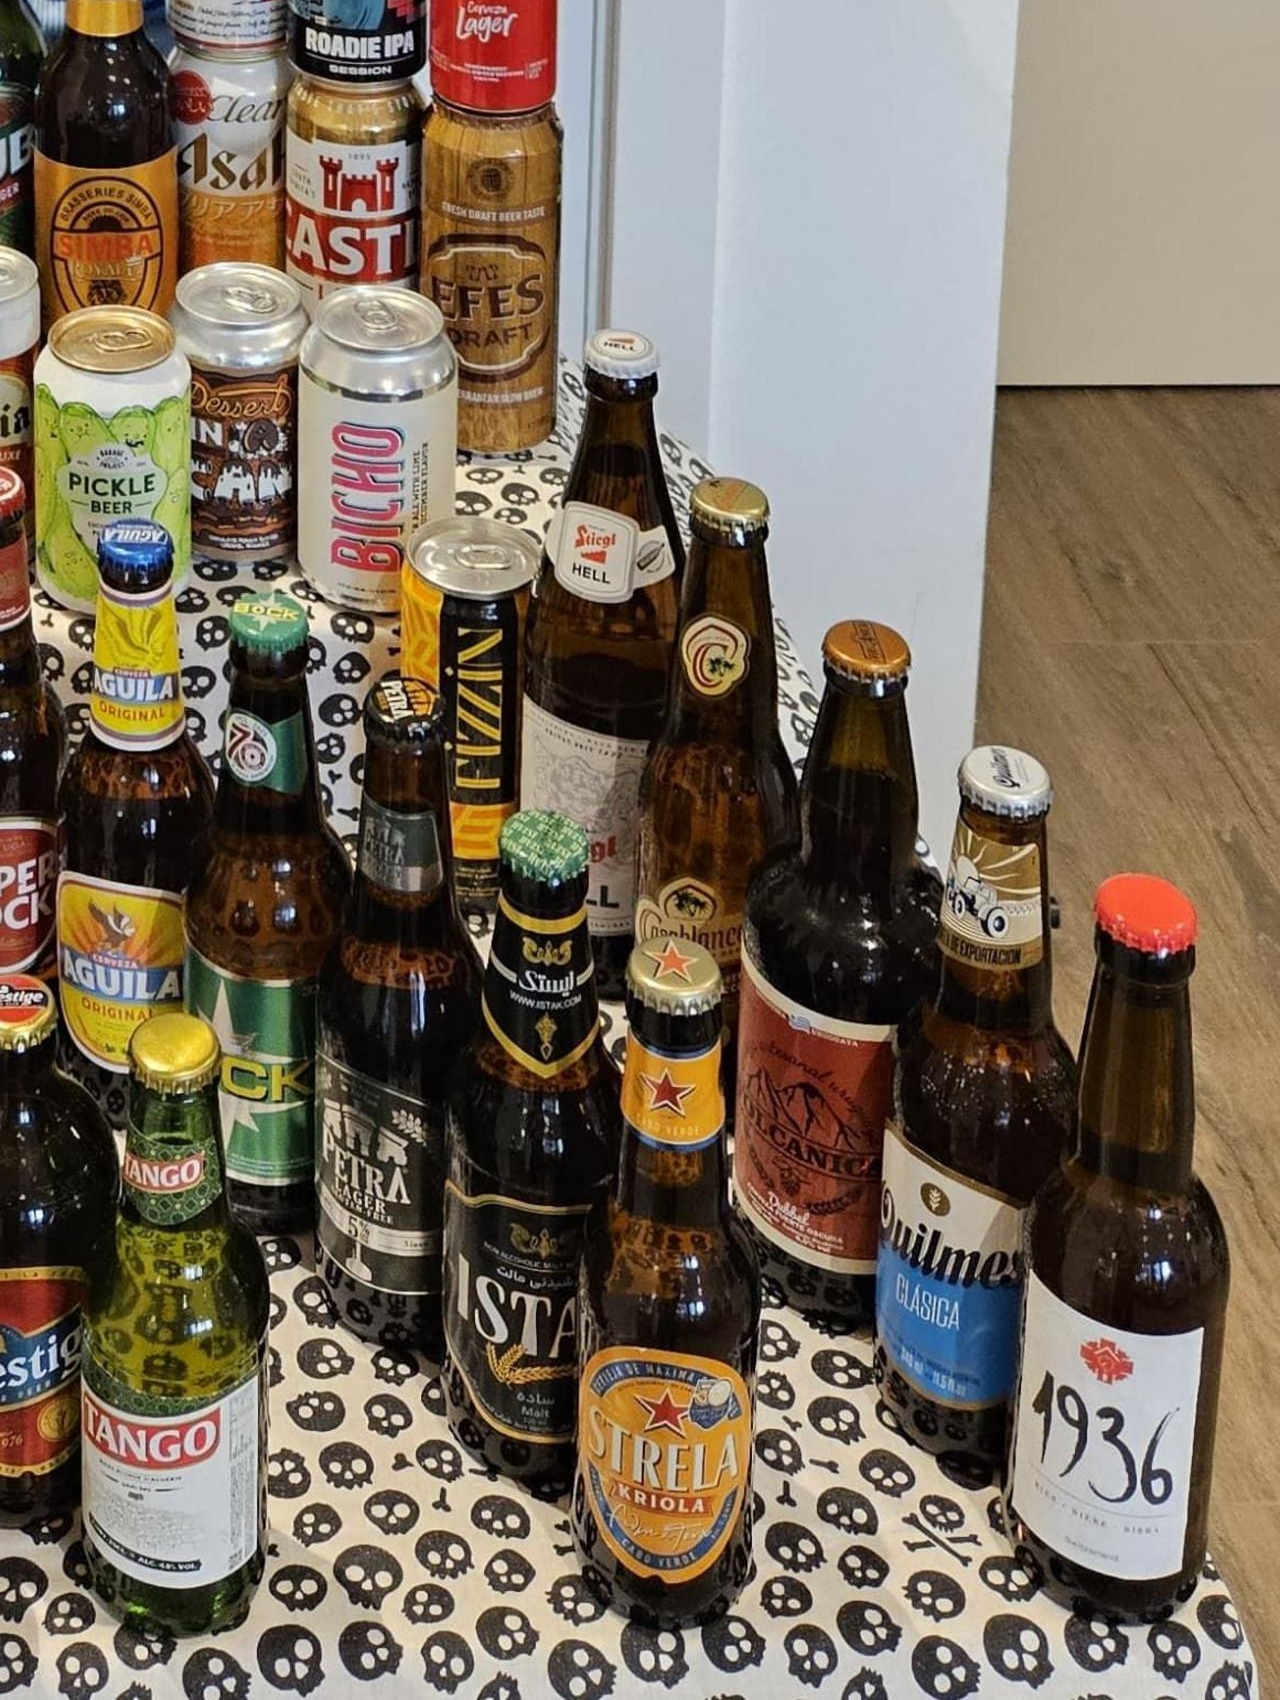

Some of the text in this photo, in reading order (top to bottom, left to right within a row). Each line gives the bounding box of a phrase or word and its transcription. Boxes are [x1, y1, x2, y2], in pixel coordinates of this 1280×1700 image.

[456, 6, 518, 42] Lager
[305, 26, 415, 60] ROADIE IPA
[328, 64, 392, 76] SESSION
[61, 185, 125, 223] BRASSERIES
[467, 208, 497, 223] DRAFT
[499, 210, 522, 222] BEER
[523, 205, 545, 220] TASTE
[58, 233, 155, 260] SIMBA
[431, 273, 546, 322] EFES
[449, 322, 533, 349] DRAFT
[603, 341, 636, 351] HELL
[191, 374, 291, 418] Dessert
[68, 472, 156, 498] PICKLE
[330, 421, 403, 573] BICHO
[91, 499, 134, 514] BEER
[574, 524, 616, 549] Stiegl
[571, 563, 611, 585] HELL
[233, 602, 300, 621] BOCK
[93, 668, 174, 702] AGUILA
[99, 701, 166, 722] ORIGINAL
[63, 950, 182, 1000] AGUILA
[91, 954, 141, 969] CERVEZA
[509, 989, 583, 1010] WWW.ISTAK.COM
[222, 1055, 312, 1103] CK
[124, 1154, 202, 1188] TANGO
[895, 1273, 961, 1332] CLÁSICA
[521, 1405, 550, 1419] Malt
[84, 1396, 218, 1464] TANGO
[1031, 1369, 1181, 1505] 1936
[588, 1404, 739, 1493] STRELA
[618, 1482, 705, 1513] KRIOLA
